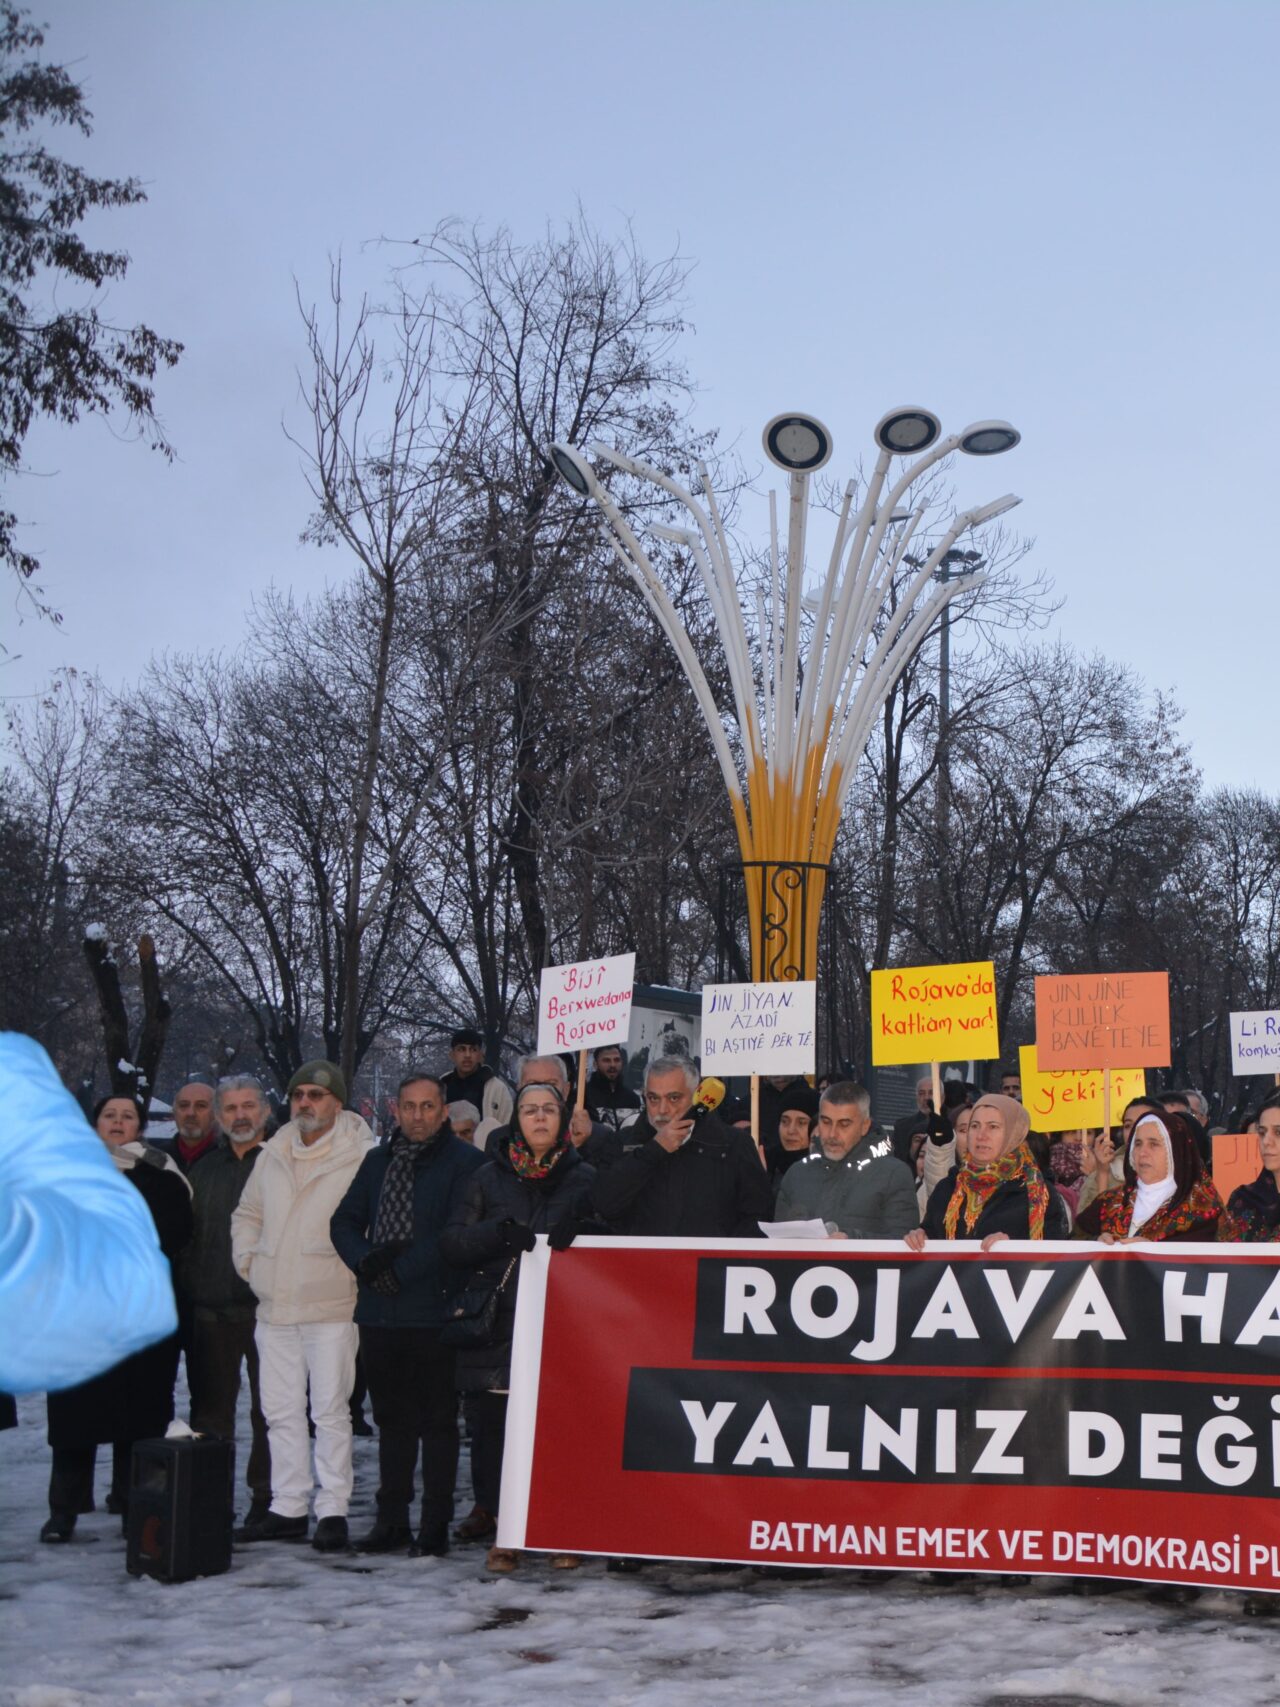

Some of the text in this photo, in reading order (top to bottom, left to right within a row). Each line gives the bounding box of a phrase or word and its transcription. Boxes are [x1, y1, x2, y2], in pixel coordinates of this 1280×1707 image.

[547, 990, 632, 1020] Berxwedana
[1049, 982, 1080, 1003] JIN
[882, 1012, 952, 1036] katliam
[1241, 1020, 1256, 1036] Li
[705, 1038, 716, 1056] BI
[771, 1032, 793, 1048] PÊK
[723, 1264, 1127, 1362] ROJAVA
[681, 1399, 1028, 1475] YALNIZ
[750, 1520, 886, 1556] BATMAN
[896, 1527, 990, 1559] EMEK
[998, 1529, 1043, 1561] VE
[1053, 1531, 1240, 1575] DEMOKRASİ
